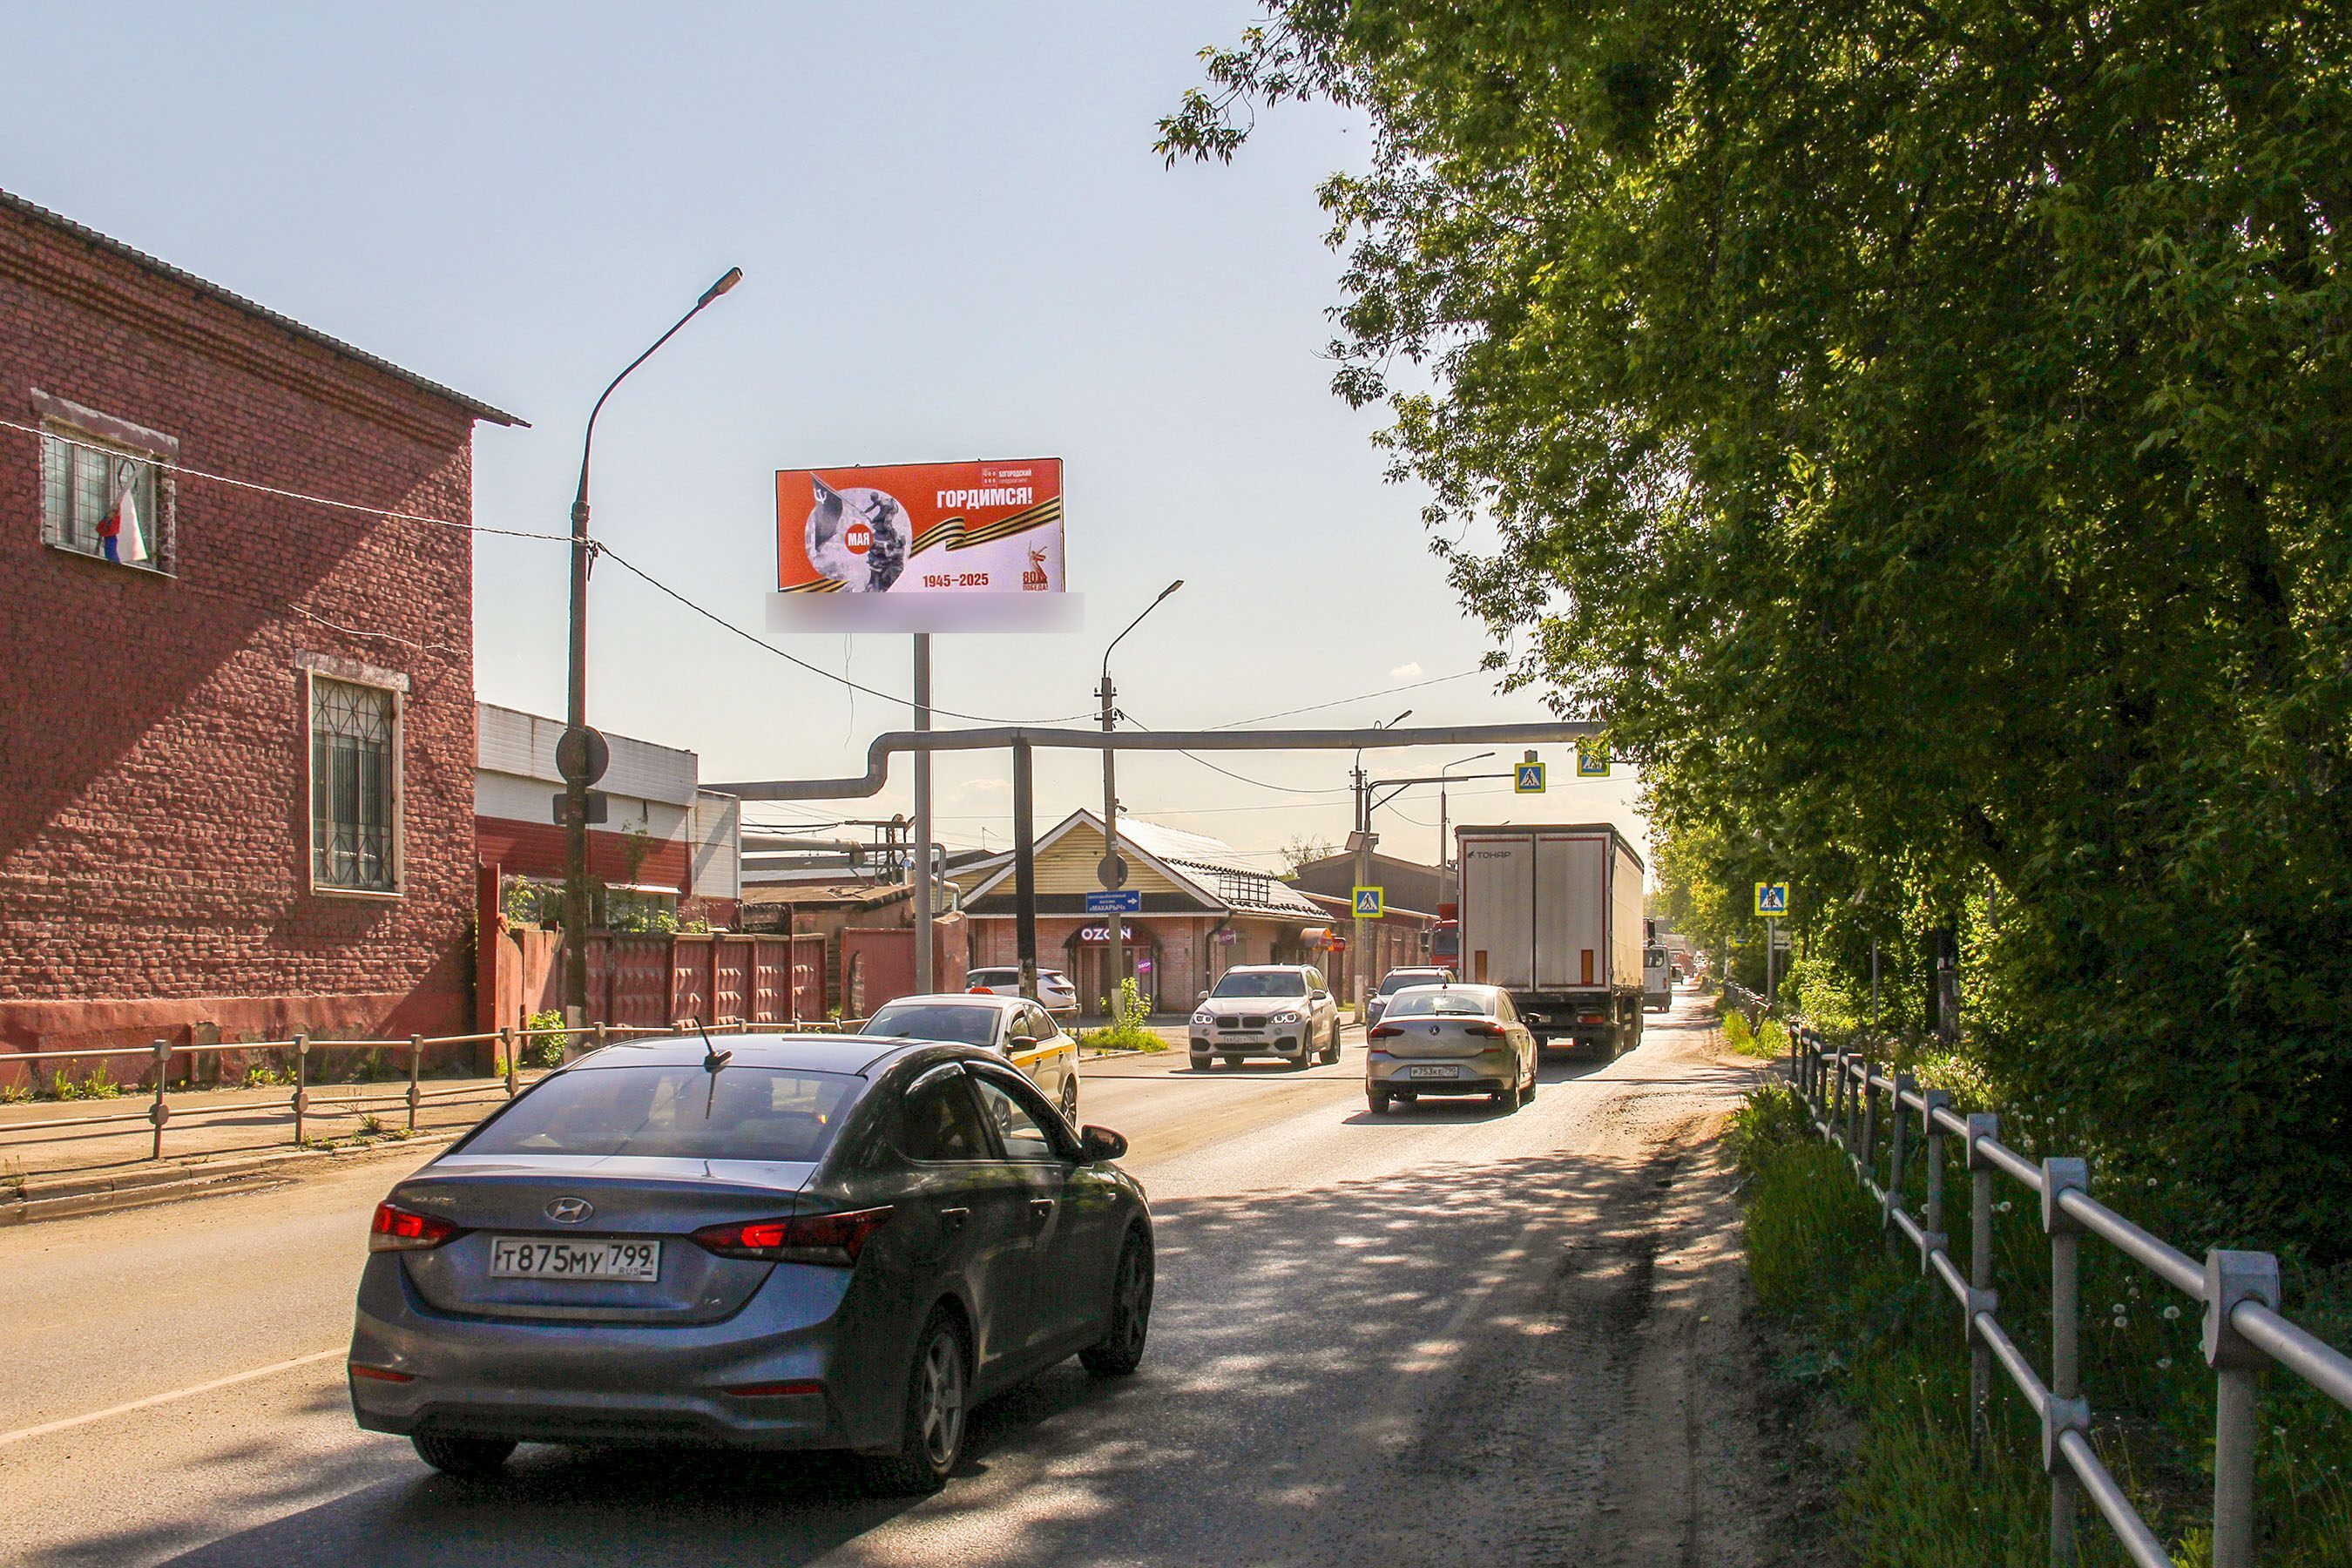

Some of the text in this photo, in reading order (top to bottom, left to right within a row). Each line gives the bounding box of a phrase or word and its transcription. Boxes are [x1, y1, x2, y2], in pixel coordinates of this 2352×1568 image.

[936, 486, 1033, 510] ГОРДИМСЯ!
[848, 532, 870, 546] МАЯ
[1023, 571, 1037, 583] 80
[503, 1244, 652, 1274] Т875МУ 799
[618, 1267, 639, 1276] RUS
